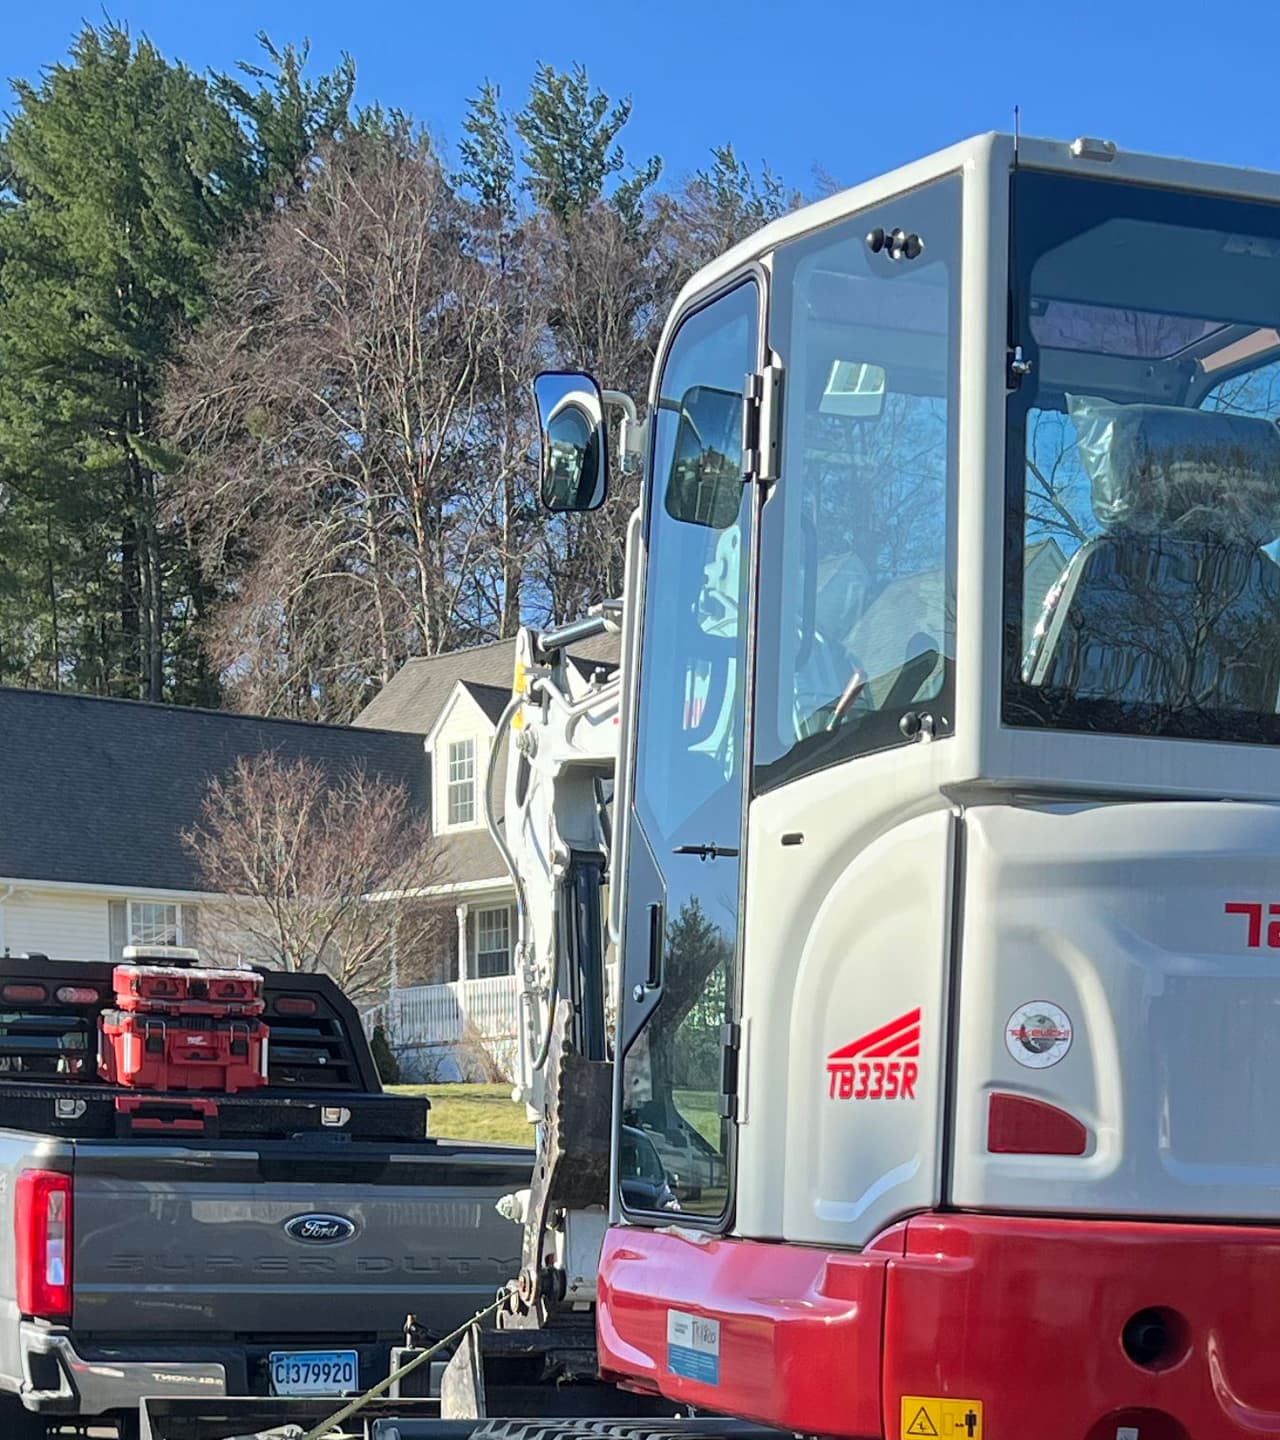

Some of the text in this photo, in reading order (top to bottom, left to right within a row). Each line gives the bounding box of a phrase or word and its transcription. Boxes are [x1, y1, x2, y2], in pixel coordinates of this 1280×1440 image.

[826, 1062, 917, 1100] TB335R
[301, 1220, 339, 1237] Ford
[104, 1254, 521, 1274] SUPER DUTY
